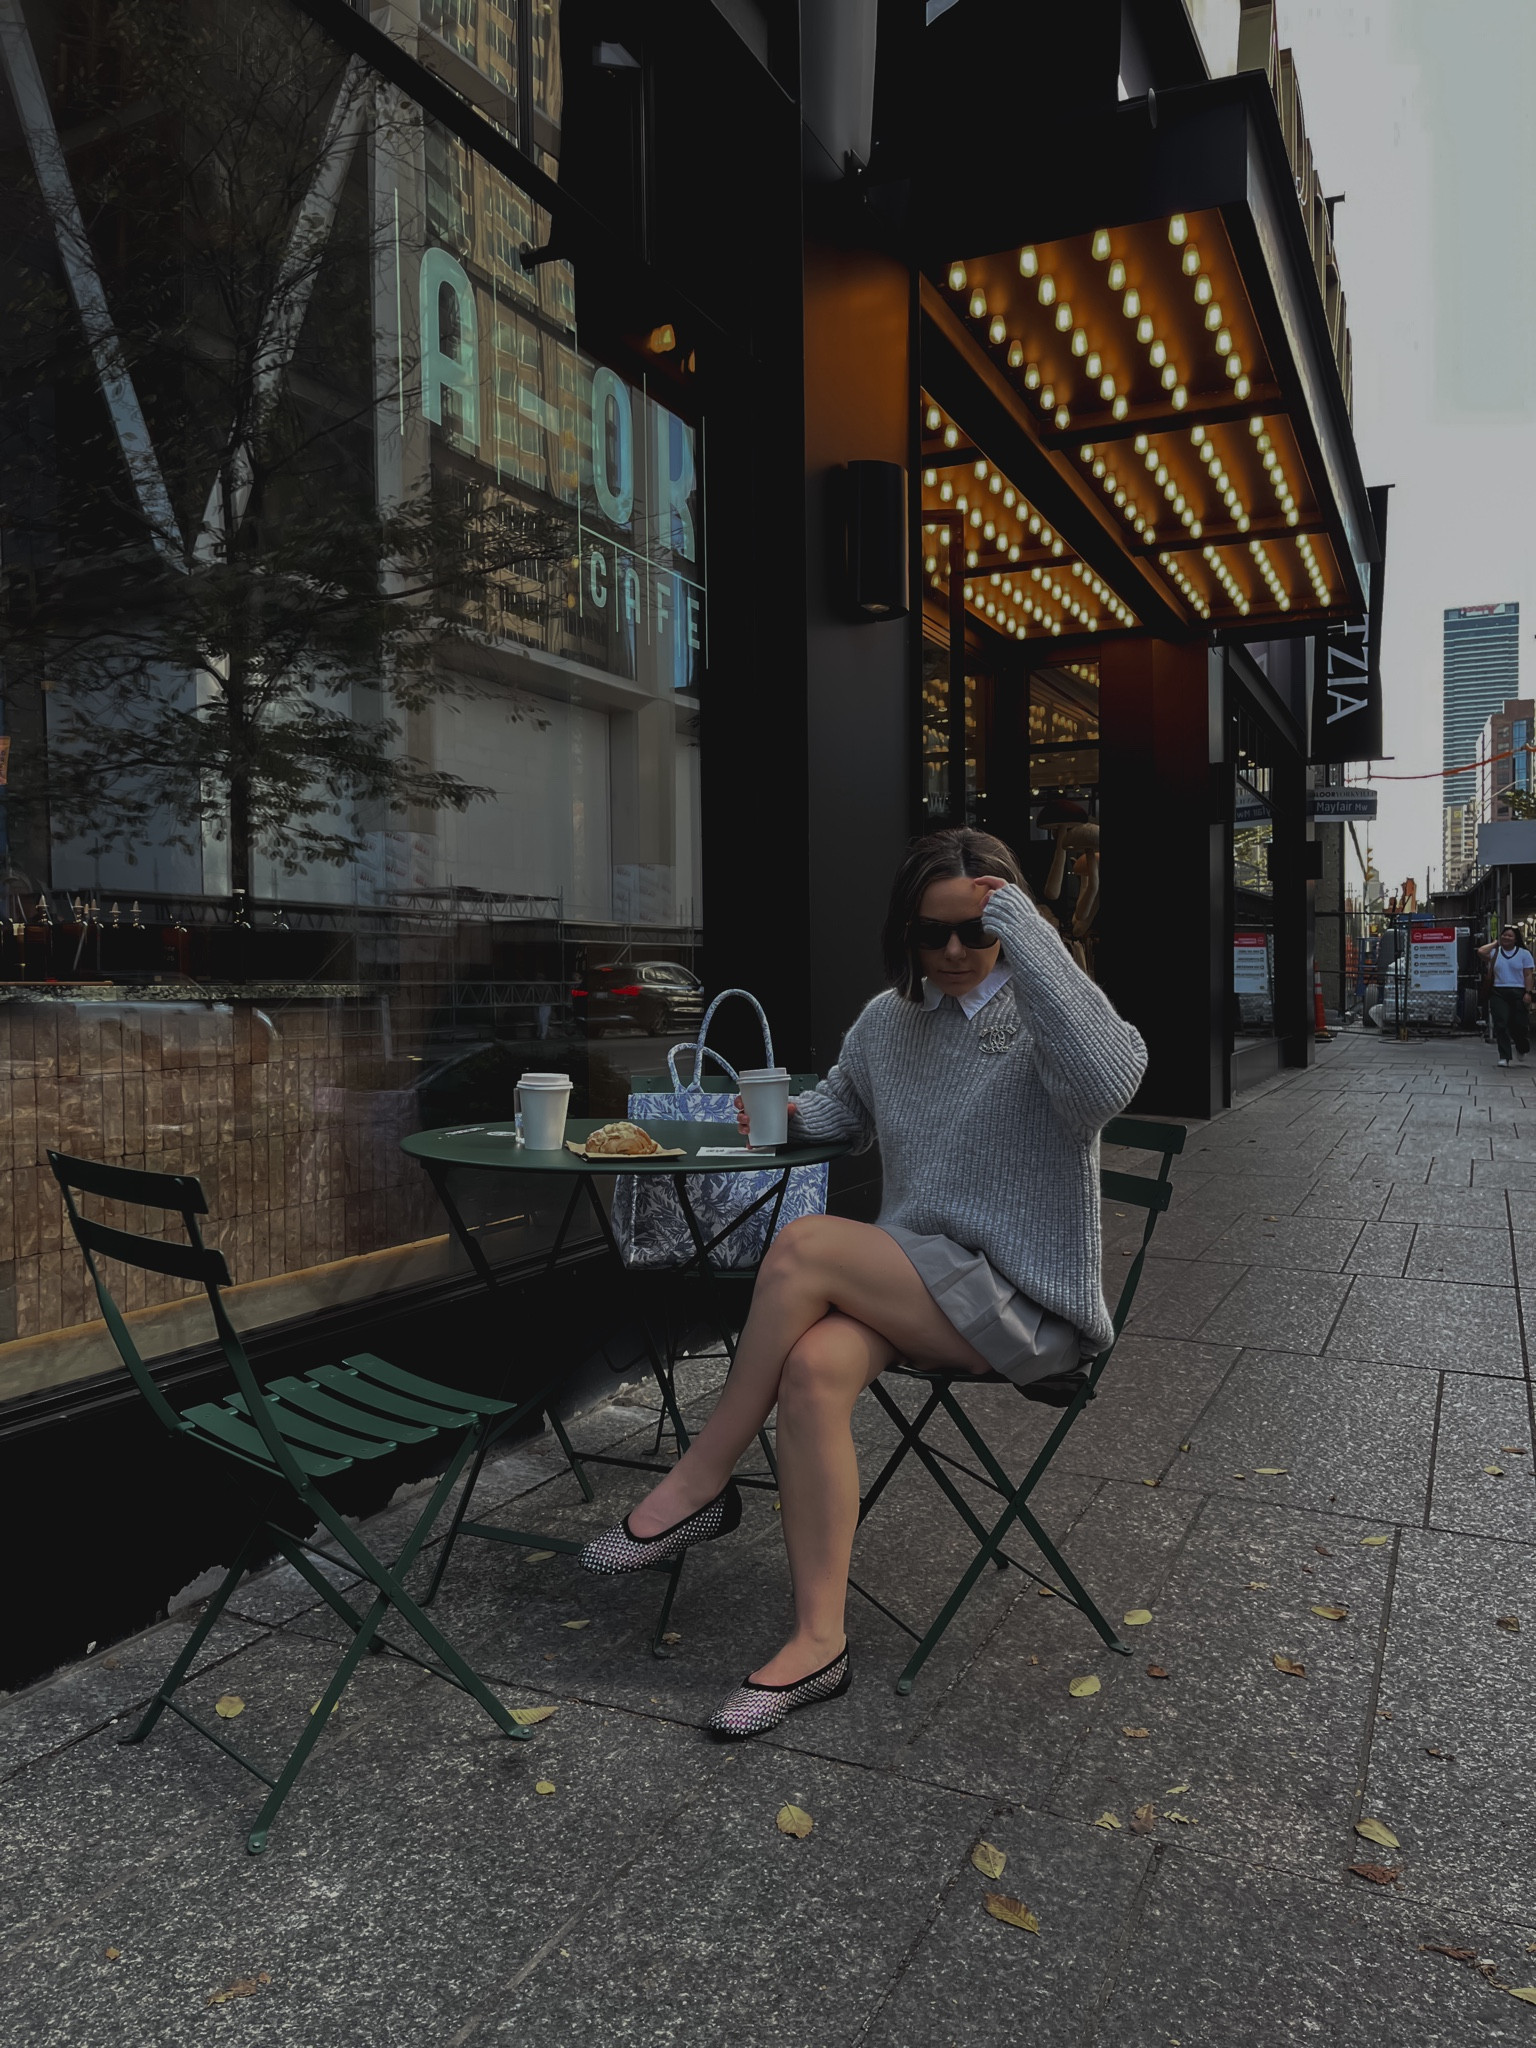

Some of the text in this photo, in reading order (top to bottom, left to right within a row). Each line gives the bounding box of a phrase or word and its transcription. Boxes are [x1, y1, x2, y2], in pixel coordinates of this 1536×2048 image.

[590, 551, 700, 650] CAFE
[1316, 801, 1368, 814] Mayfair Mw
